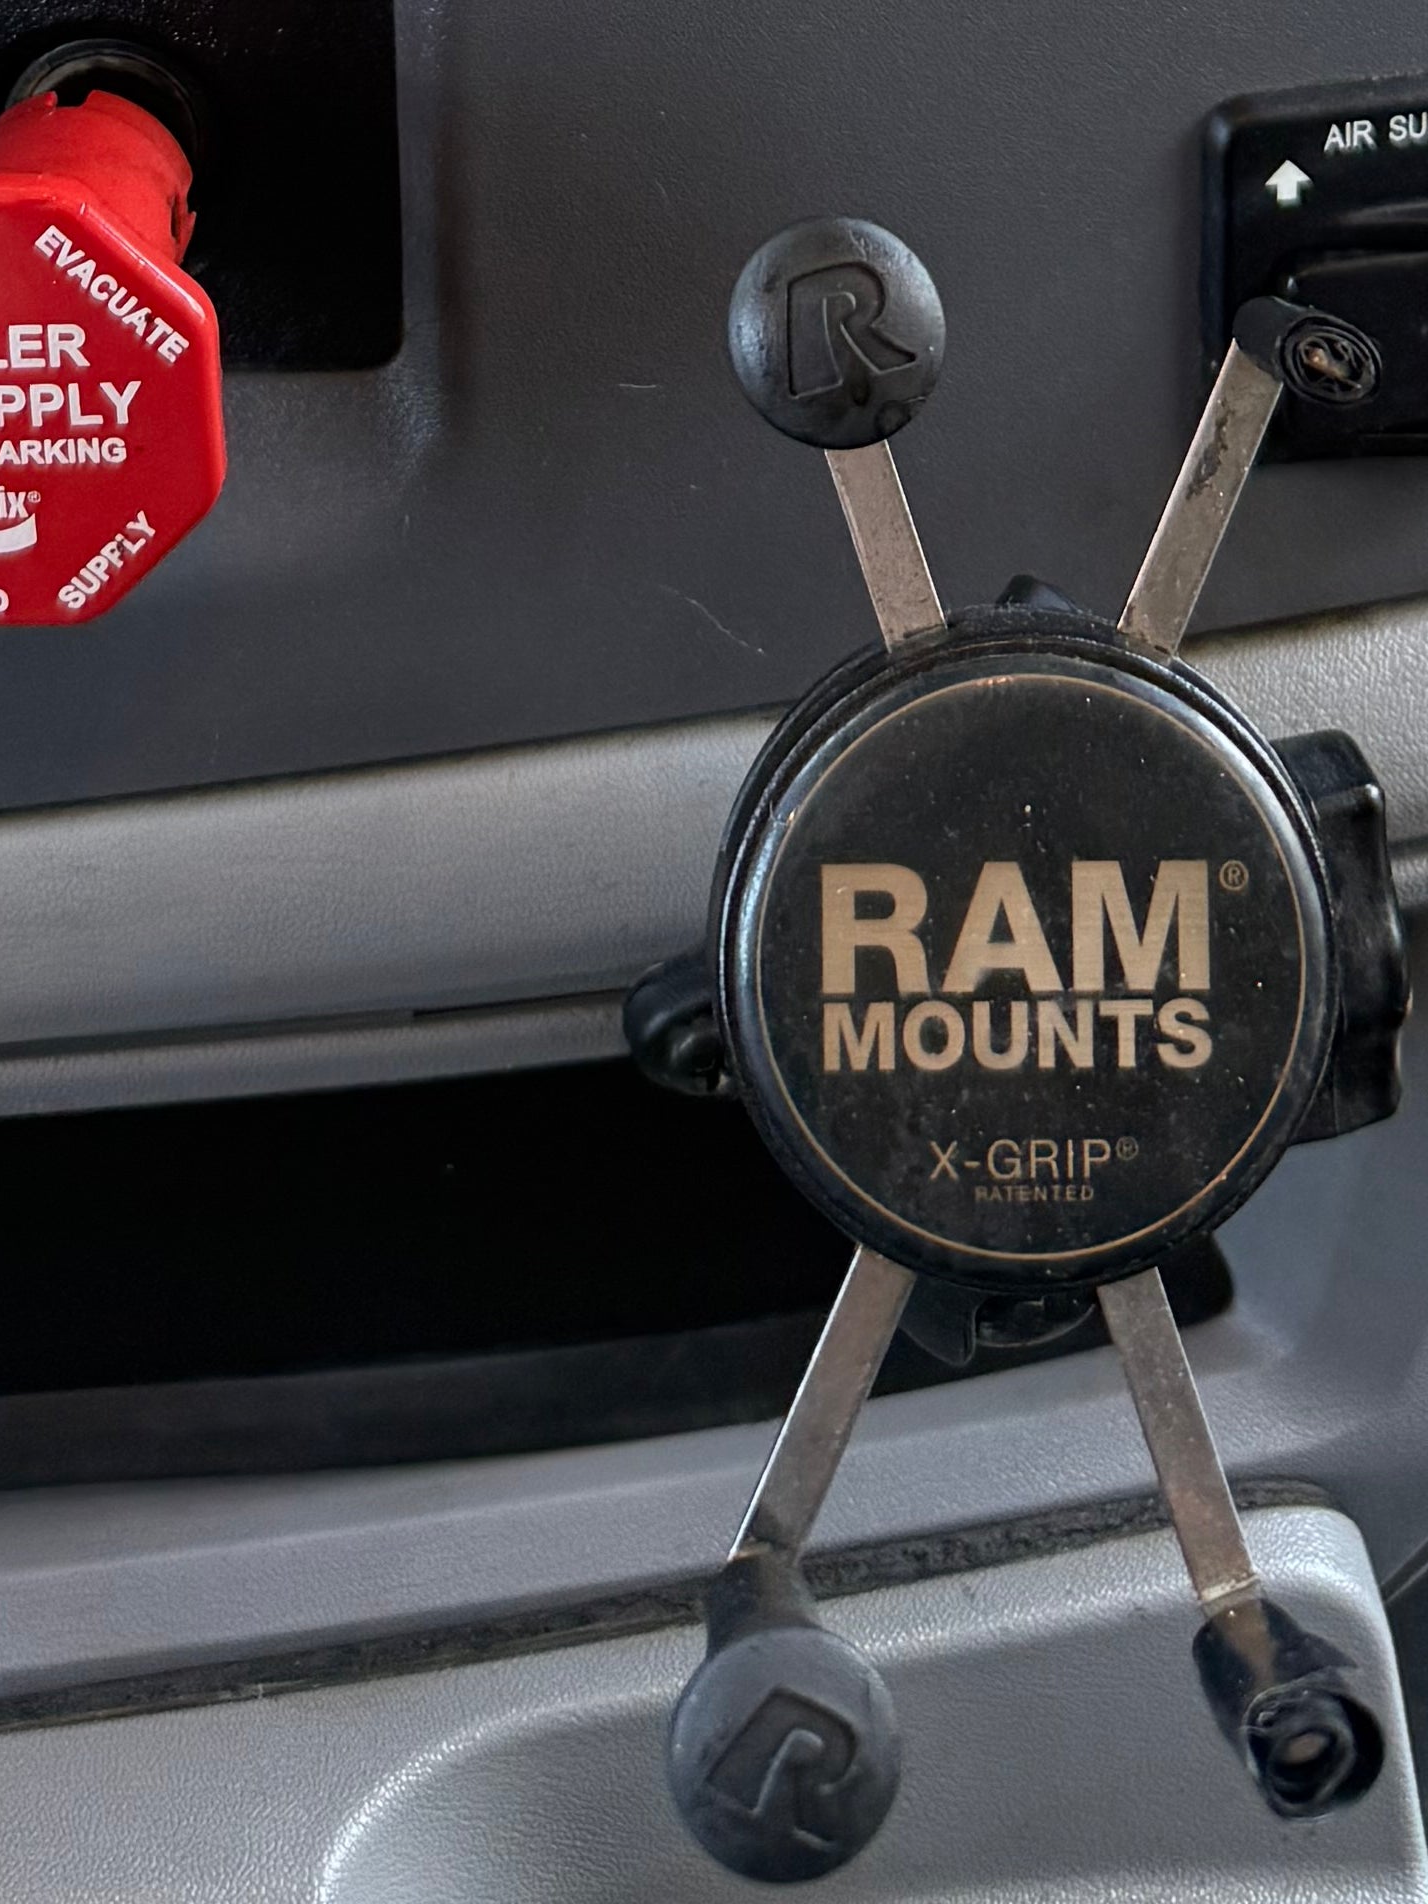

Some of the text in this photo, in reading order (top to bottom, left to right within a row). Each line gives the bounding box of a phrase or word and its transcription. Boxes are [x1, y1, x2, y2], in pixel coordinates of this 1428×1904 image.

[1323, 119, 1374, 154] AIR
[33, 224, 191, 364] EVACUATE
[57, 510, 157, 611] SUPPLY
[822, 997, 1214, 1073] MOUNTS
[974, 1185, 1095, 1202] PATENTED
